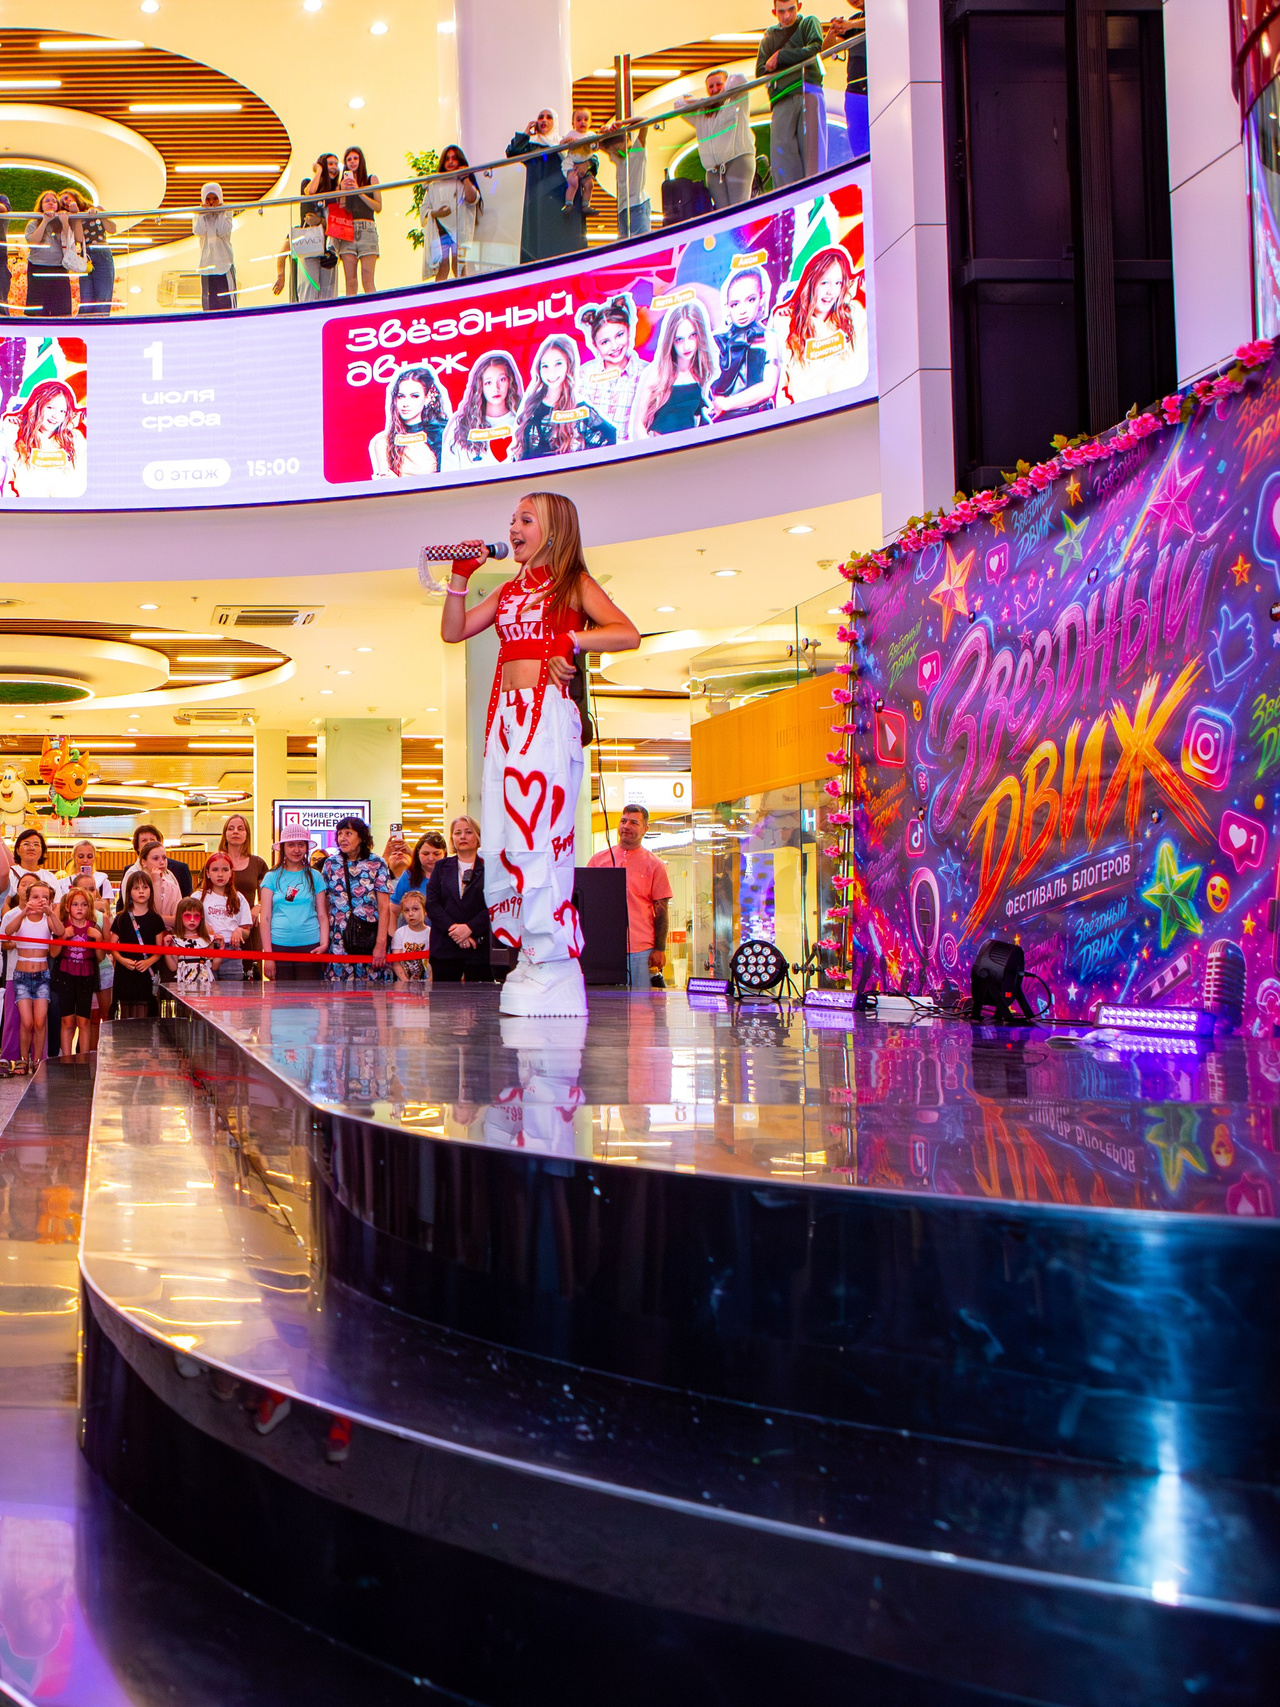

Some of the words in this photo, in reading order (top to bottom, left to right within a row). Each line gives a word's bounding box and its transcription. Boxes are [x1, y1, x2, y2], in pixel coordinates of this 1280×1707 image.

[144, 341, 163, 381] 1
[142, 388, 215, 405] июля
[141, 410, 220, 433] среда
[154, 469, 165, 482] 0
[170, 468, 219, 481] этаж
[246, 457, 300, 477] 15:00
[672, 782, 684, 798] 0
[302, 819, 340, 828] СИНЕР
[1250, 834, 1257, 854] 1
[1005, 877, 1068, 918] ФЕСТИВАЛЬ
[1072, 854, 1131, 891] БЛОГЕРОВ
